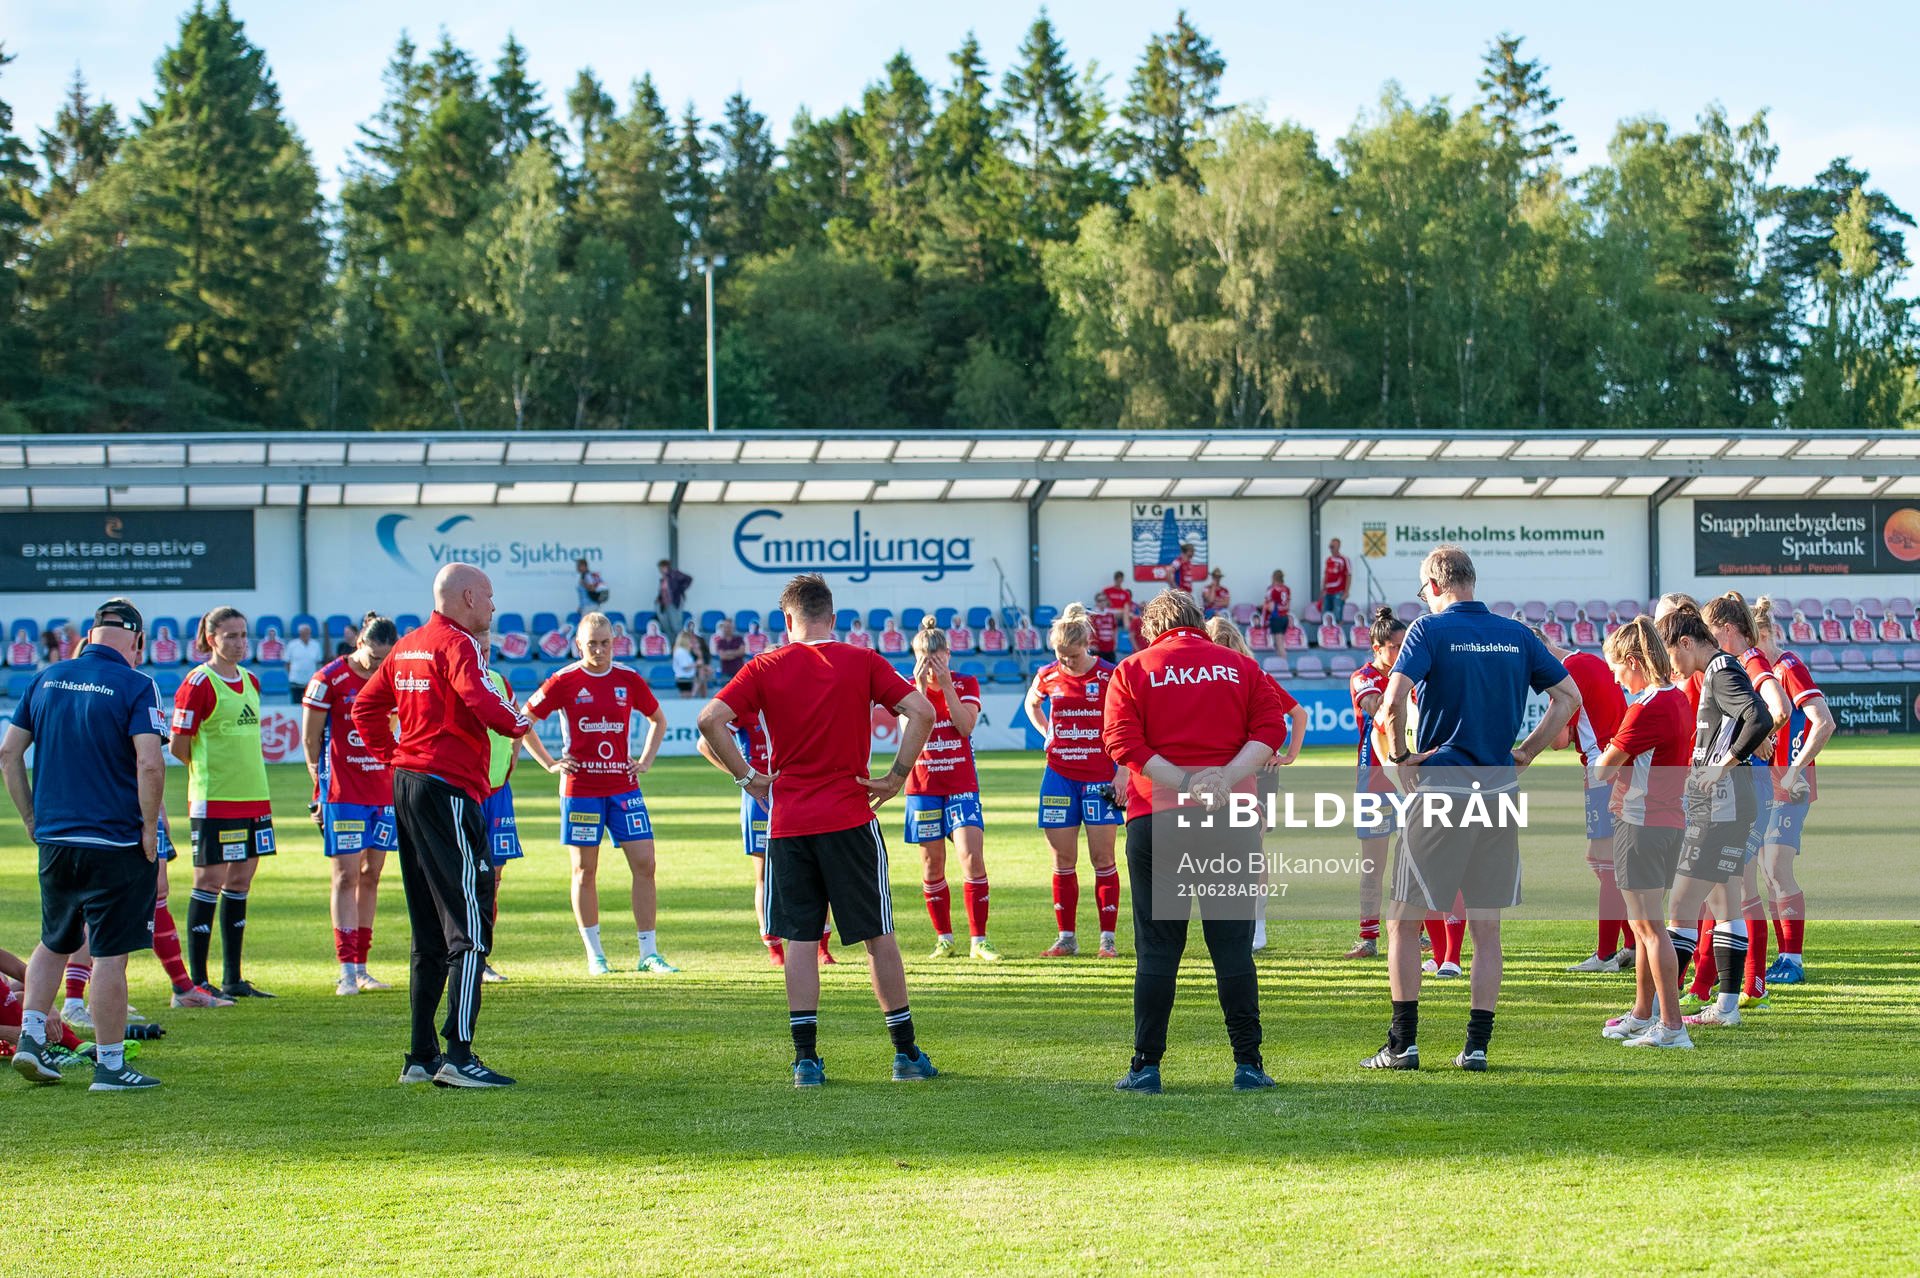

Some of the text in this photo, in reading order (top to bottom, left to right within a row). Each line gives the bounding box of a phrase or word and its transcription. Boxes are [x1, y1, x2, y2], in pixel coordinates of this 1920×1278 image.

[1700, 512, 1866, 538] Snapphanebygdens
[1395, 526, 1605, 542] Hässleholms kommun
[21, 540, 207, 558] exaktacreative
[733, 509, 973, 582] Emmaljunga
[1782, 536, 1865, 560] Sparbank
[428, 541, 603, 569] Vittsjö Sjukhem
[1450, 642, 1520, 653] #mitthässleholm
[1149, 665, 1240, 688] LÄKARE
[237, 717, 258, 726] adidas
[1840, 708, 1901, 727] Sparbank
[582, 761, 627, 770] SUNLIGHT
[1586, 809, 1599, 823] 23
[1778, 815, 1792, 829] 16
[1684, 845, 1701, 861] 13
